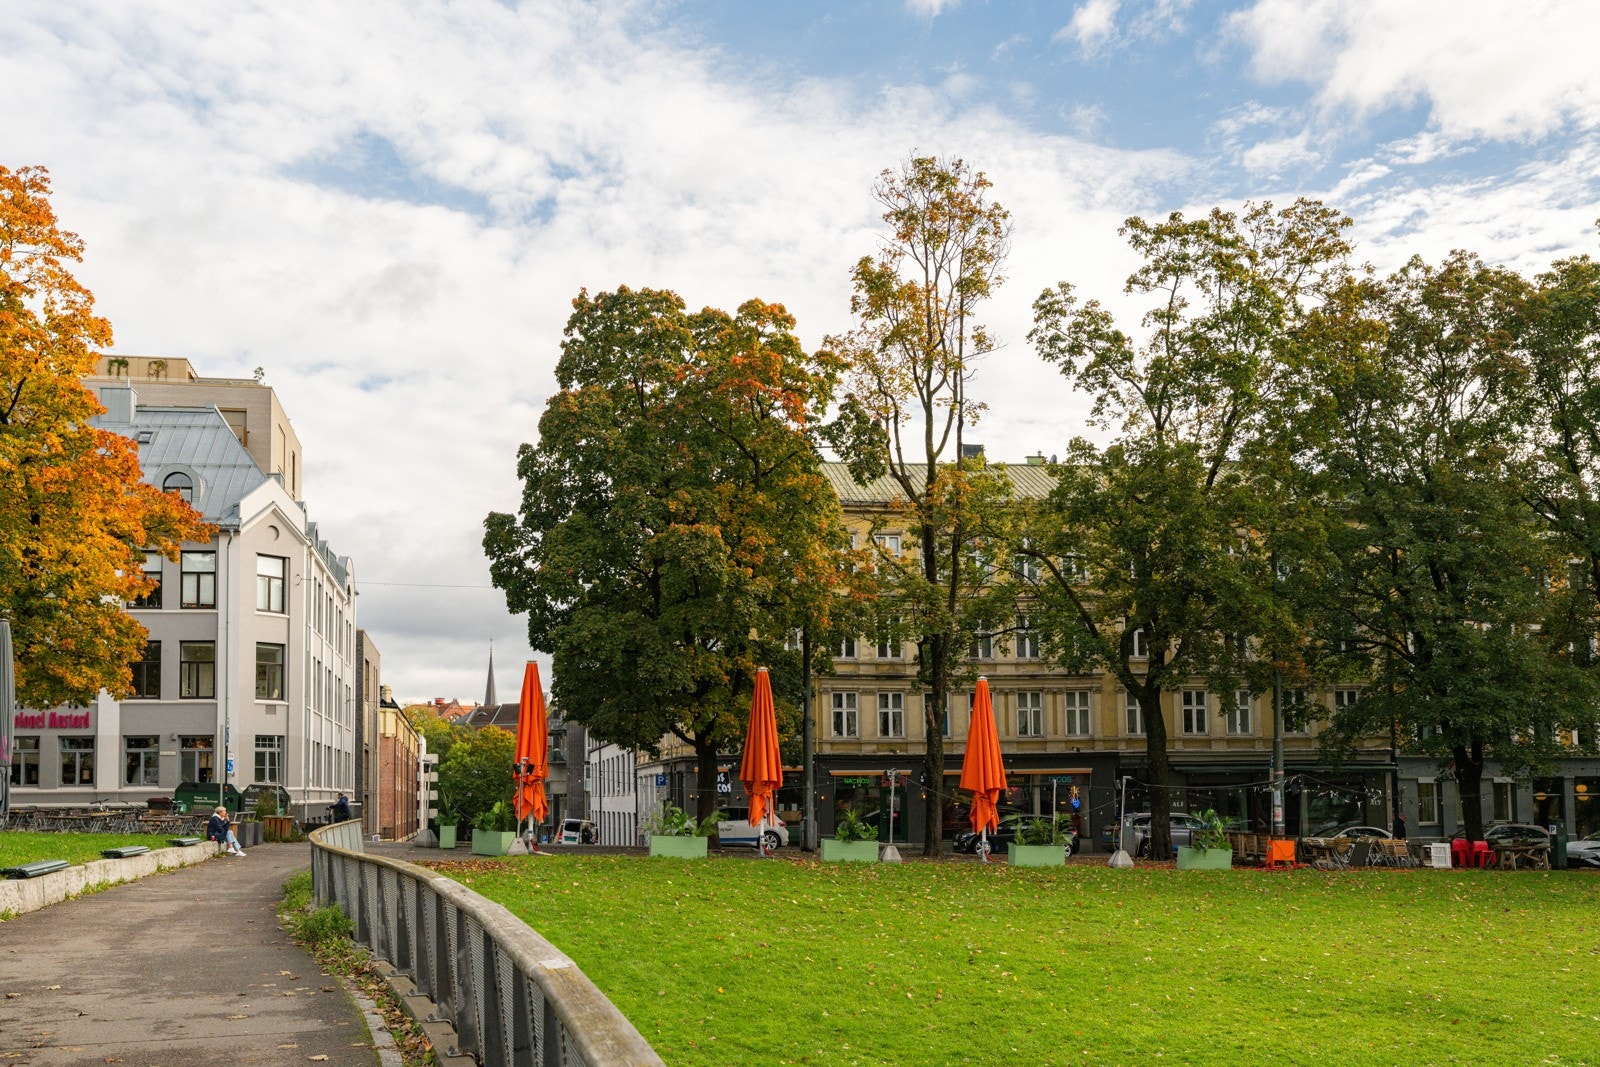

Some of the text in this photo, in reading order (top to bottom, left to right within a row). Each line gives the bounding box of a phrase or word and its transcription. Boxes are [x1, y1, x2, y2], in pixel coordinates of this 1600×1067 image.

[14, 711, 90, 729] olonel Mustard
[658, 776, 665, 785] P
